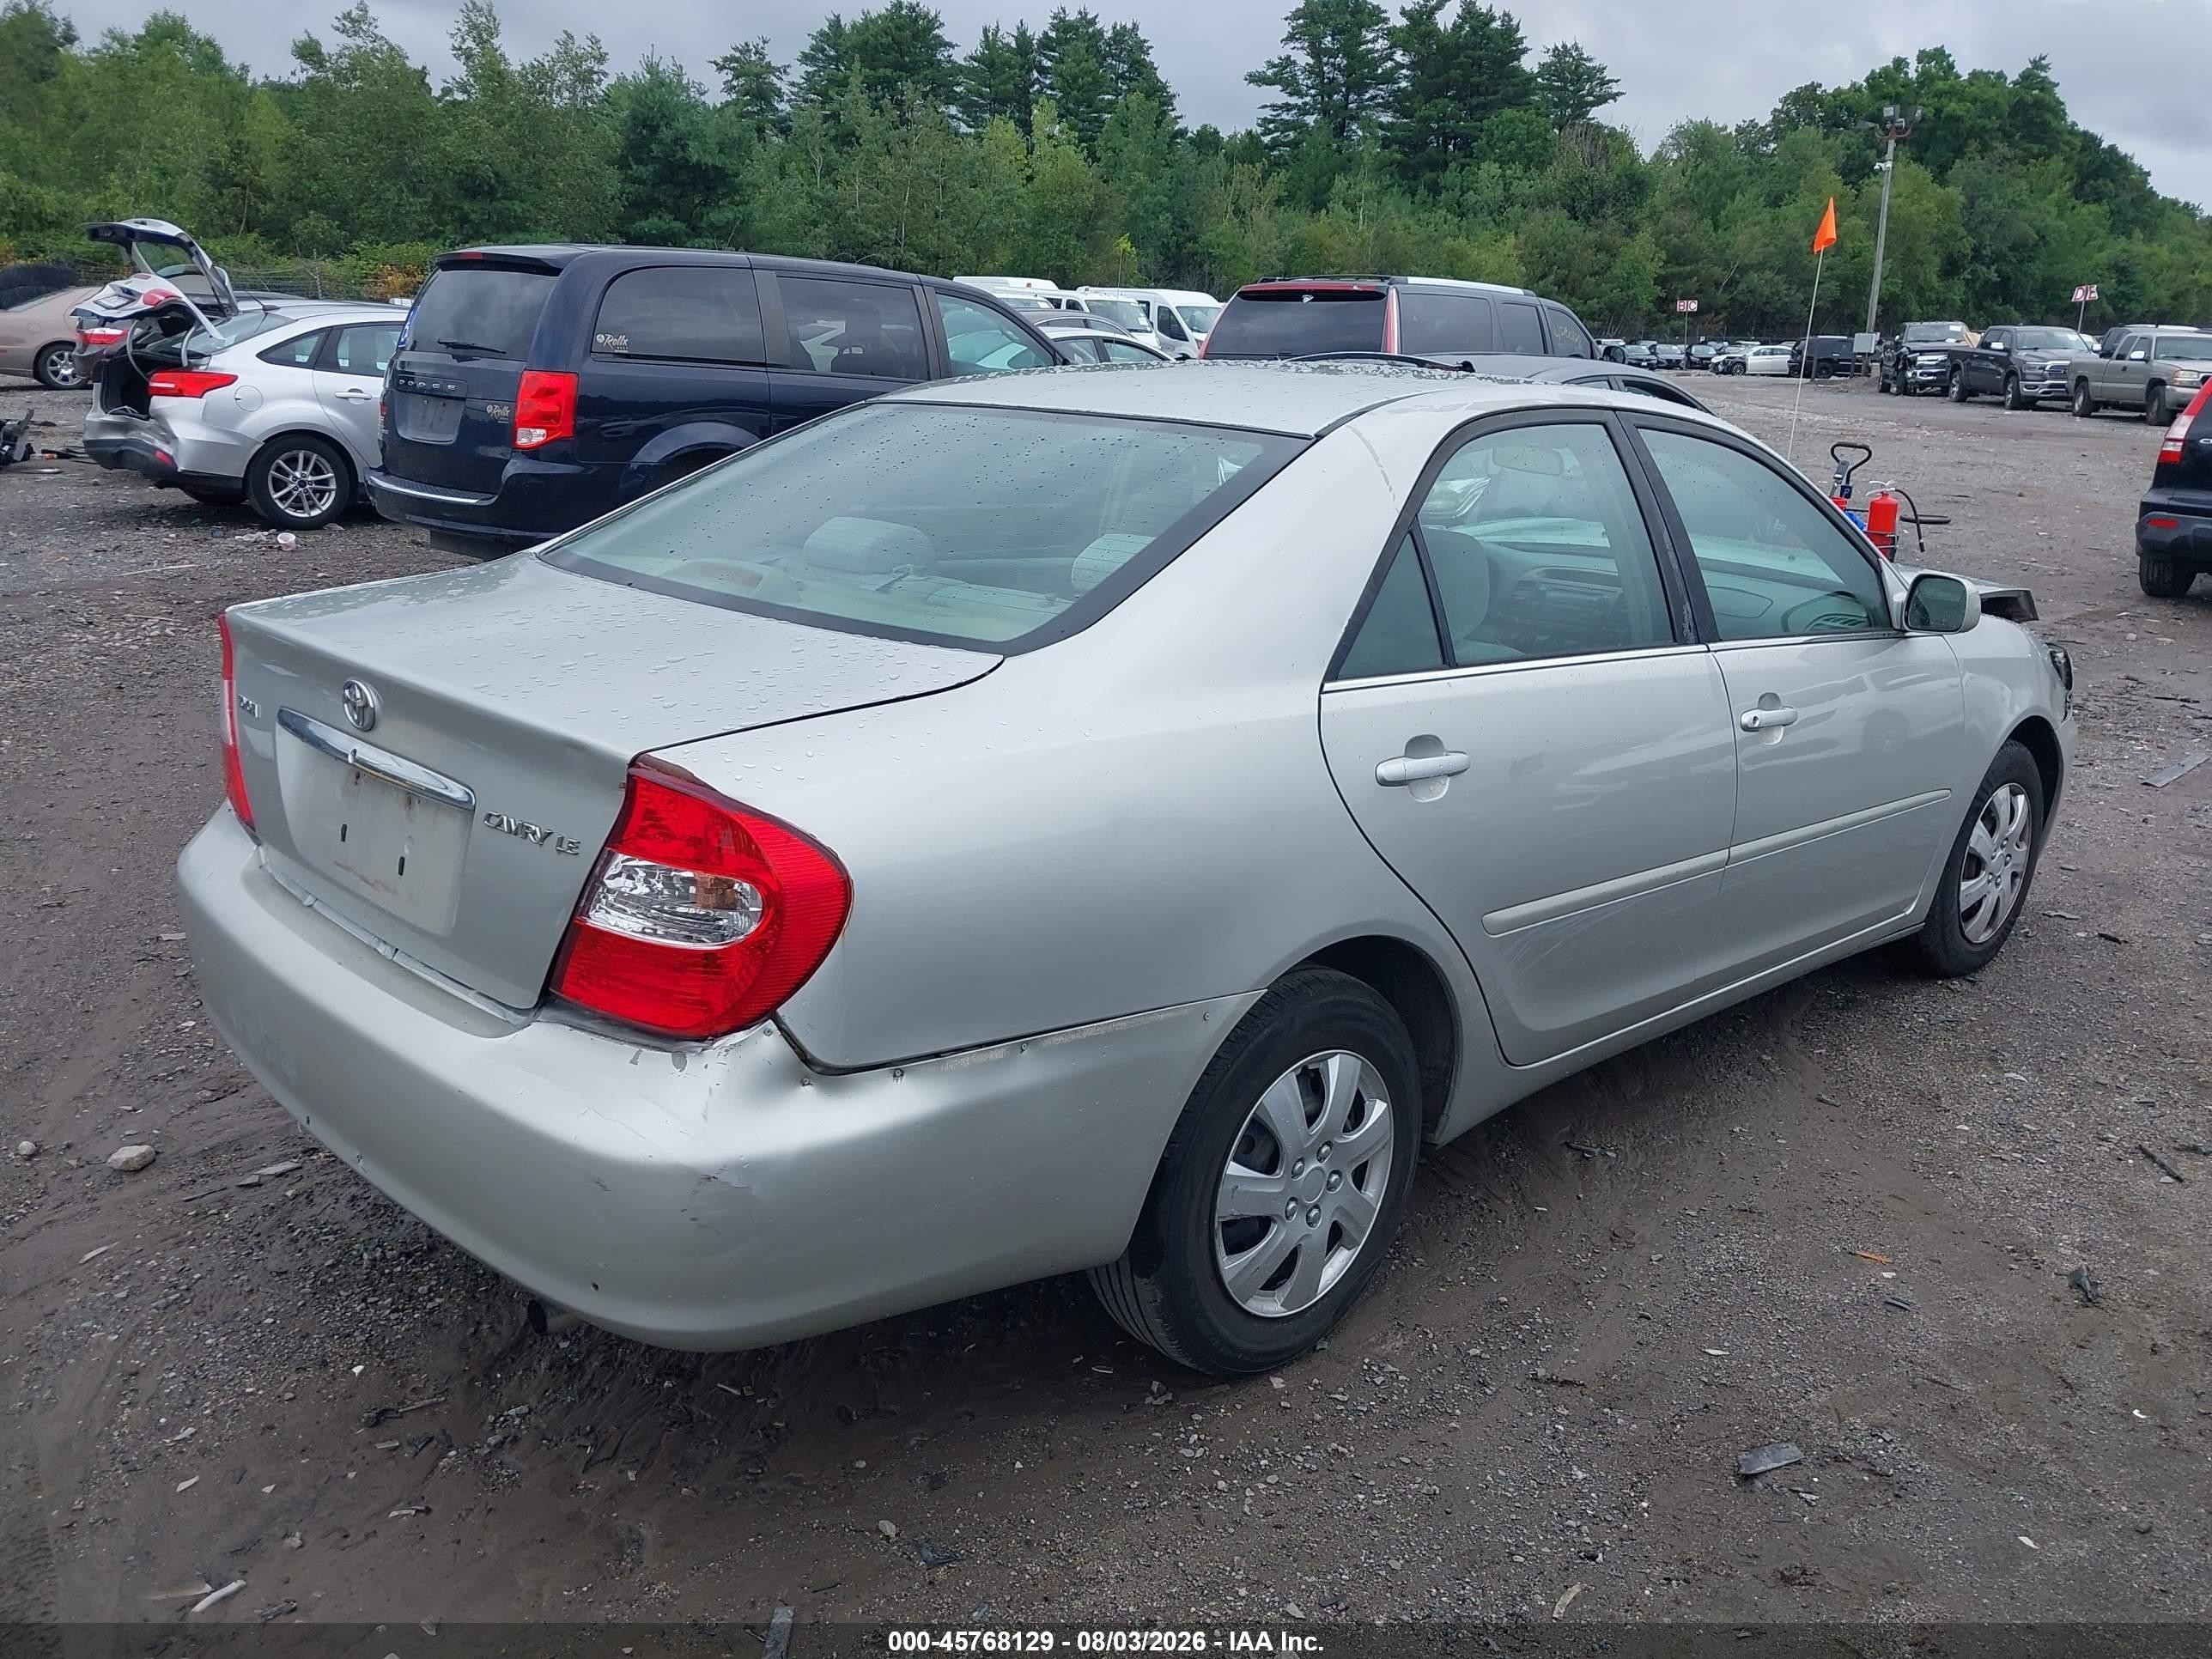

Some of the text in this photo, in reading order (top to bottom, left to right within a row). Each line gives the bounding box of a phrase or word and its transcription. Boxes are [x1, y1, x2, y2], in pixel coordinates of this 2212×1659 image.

[2074, 285, 2097, 301] D E
[1679, 301, 1697, 311] B C
[398, 379, 456, 391] DODGE
[483, 810, 581, 856] CAMRY LE
